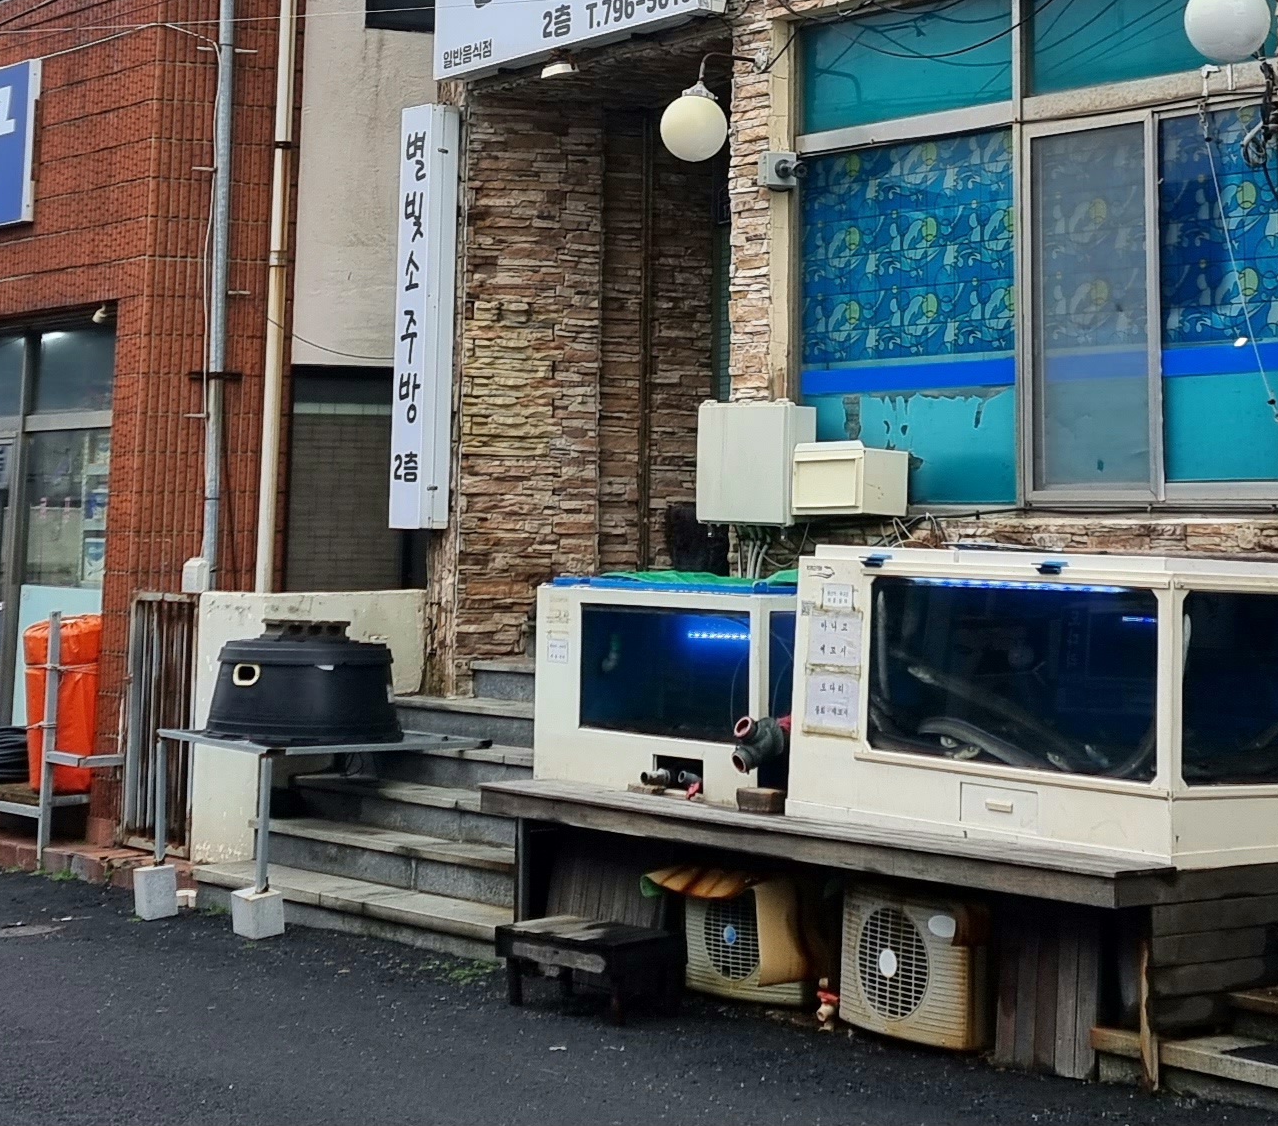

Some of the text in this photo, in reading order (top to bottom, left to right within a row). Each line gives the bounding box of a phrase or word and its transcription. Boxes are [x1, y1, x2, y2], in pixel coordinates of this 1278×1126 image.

[542, 4, 571, 39] 2층
[443, 38, 493, 70] 일반음식점
[393, 130, 427, 484] 별빛소주방 2층
